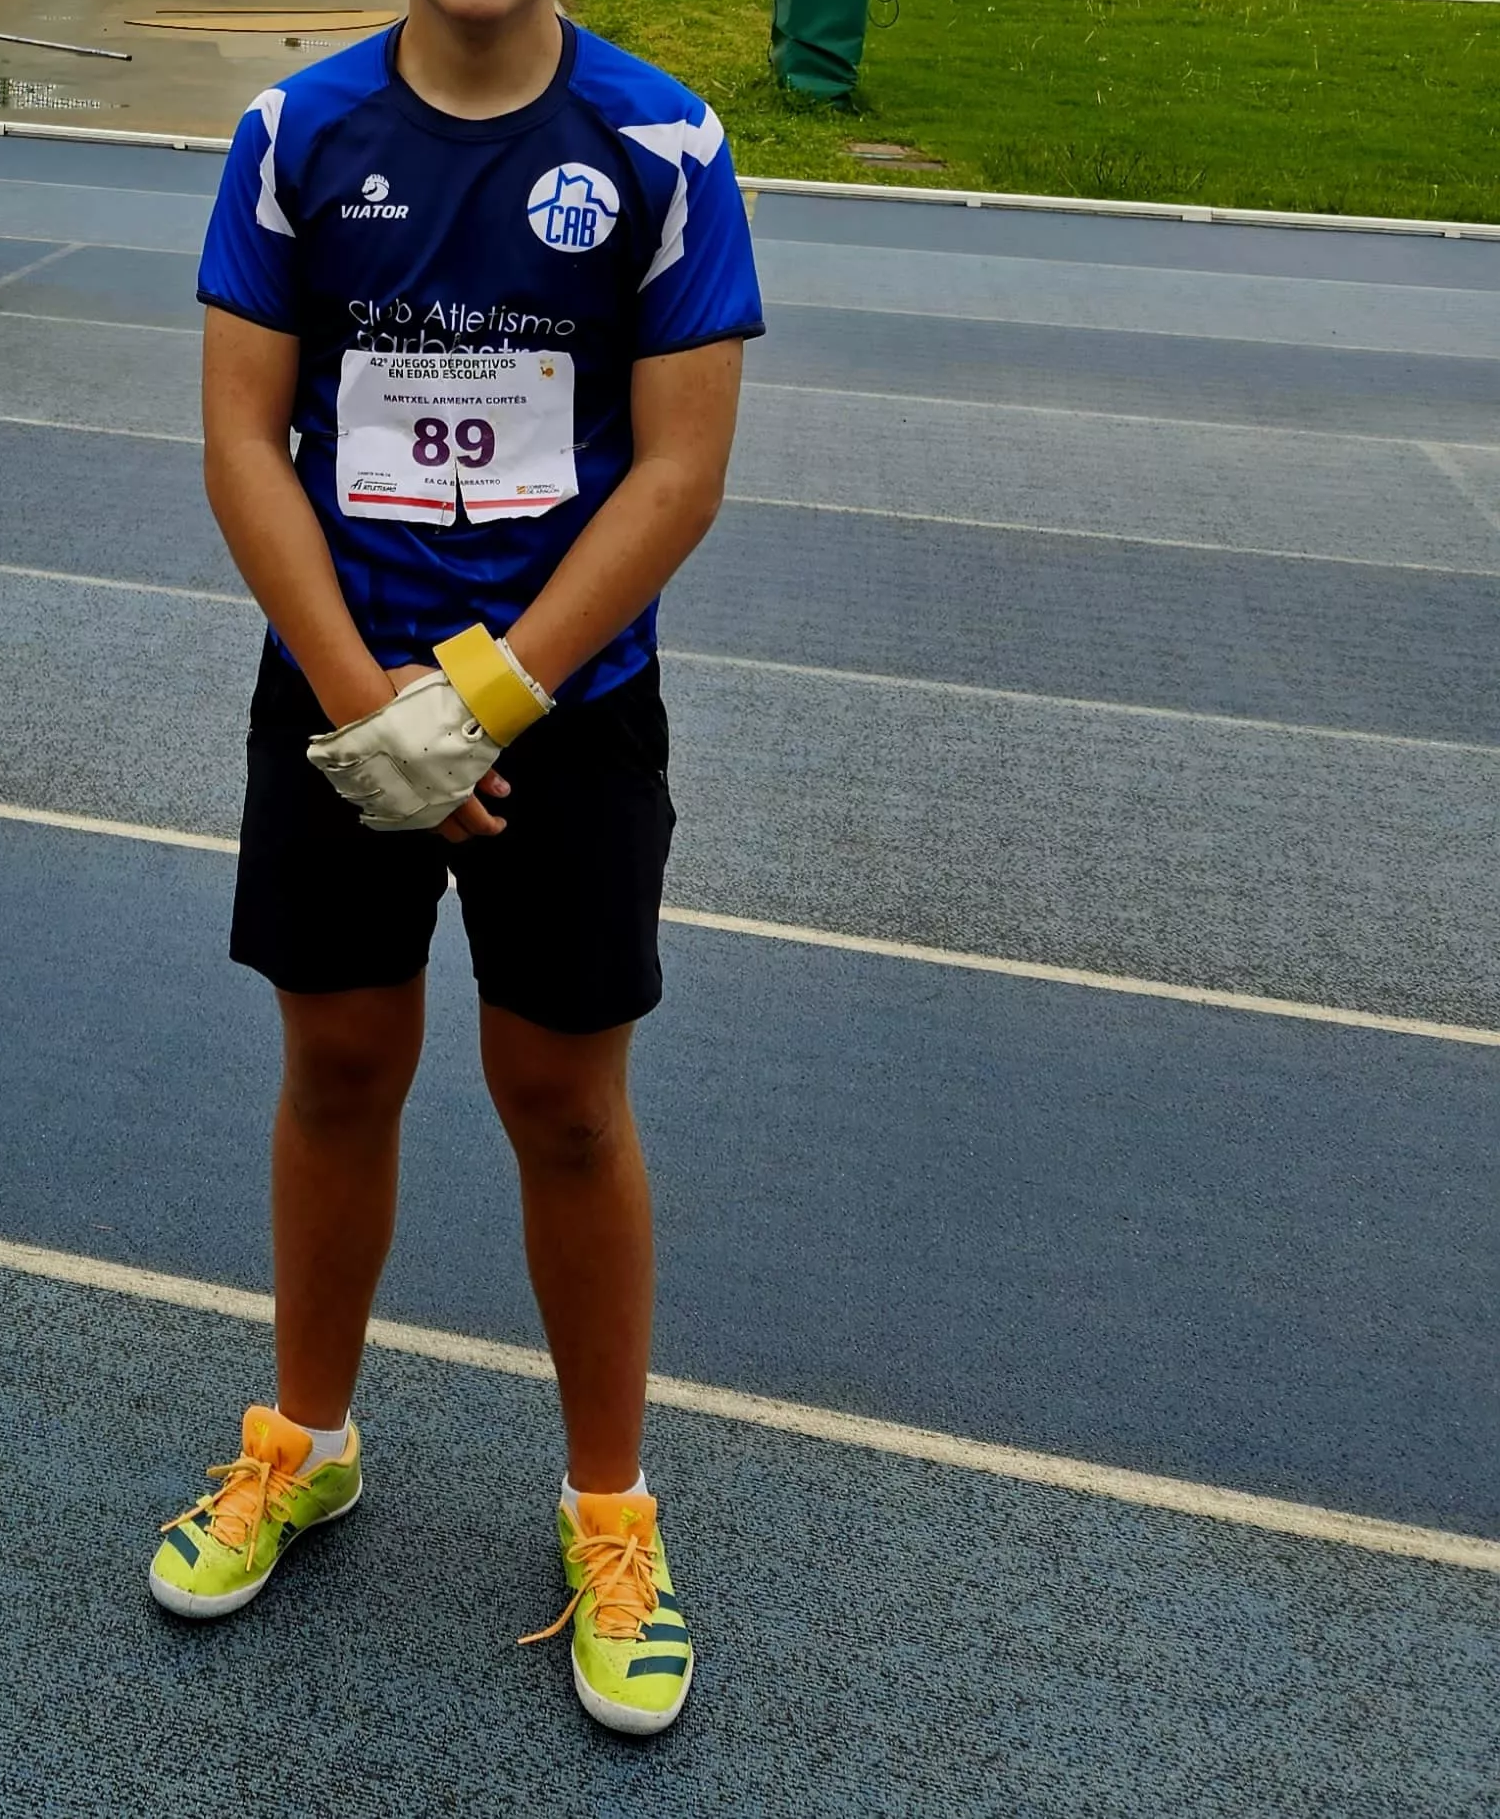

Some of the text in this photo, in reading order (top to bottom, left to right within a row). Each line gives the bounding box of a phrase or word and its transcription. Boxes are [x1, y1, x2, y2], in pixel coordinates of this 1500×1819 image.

[341, 205, 409, 219] VIATOR
[546, 205, 597, 248] CAB
[424, 300, 575, 335] Atletismo
[391, 358, 436, 369] JUEGOS
[440, 358, 517, 369] DEPORTIVOS
[388, 369, 497, 380] EN EDAD ESCOLAR
[383, 394, 527, 405] MARTXEL ARMENTA CORTÉS
[412, 417, 495, 468] 89
